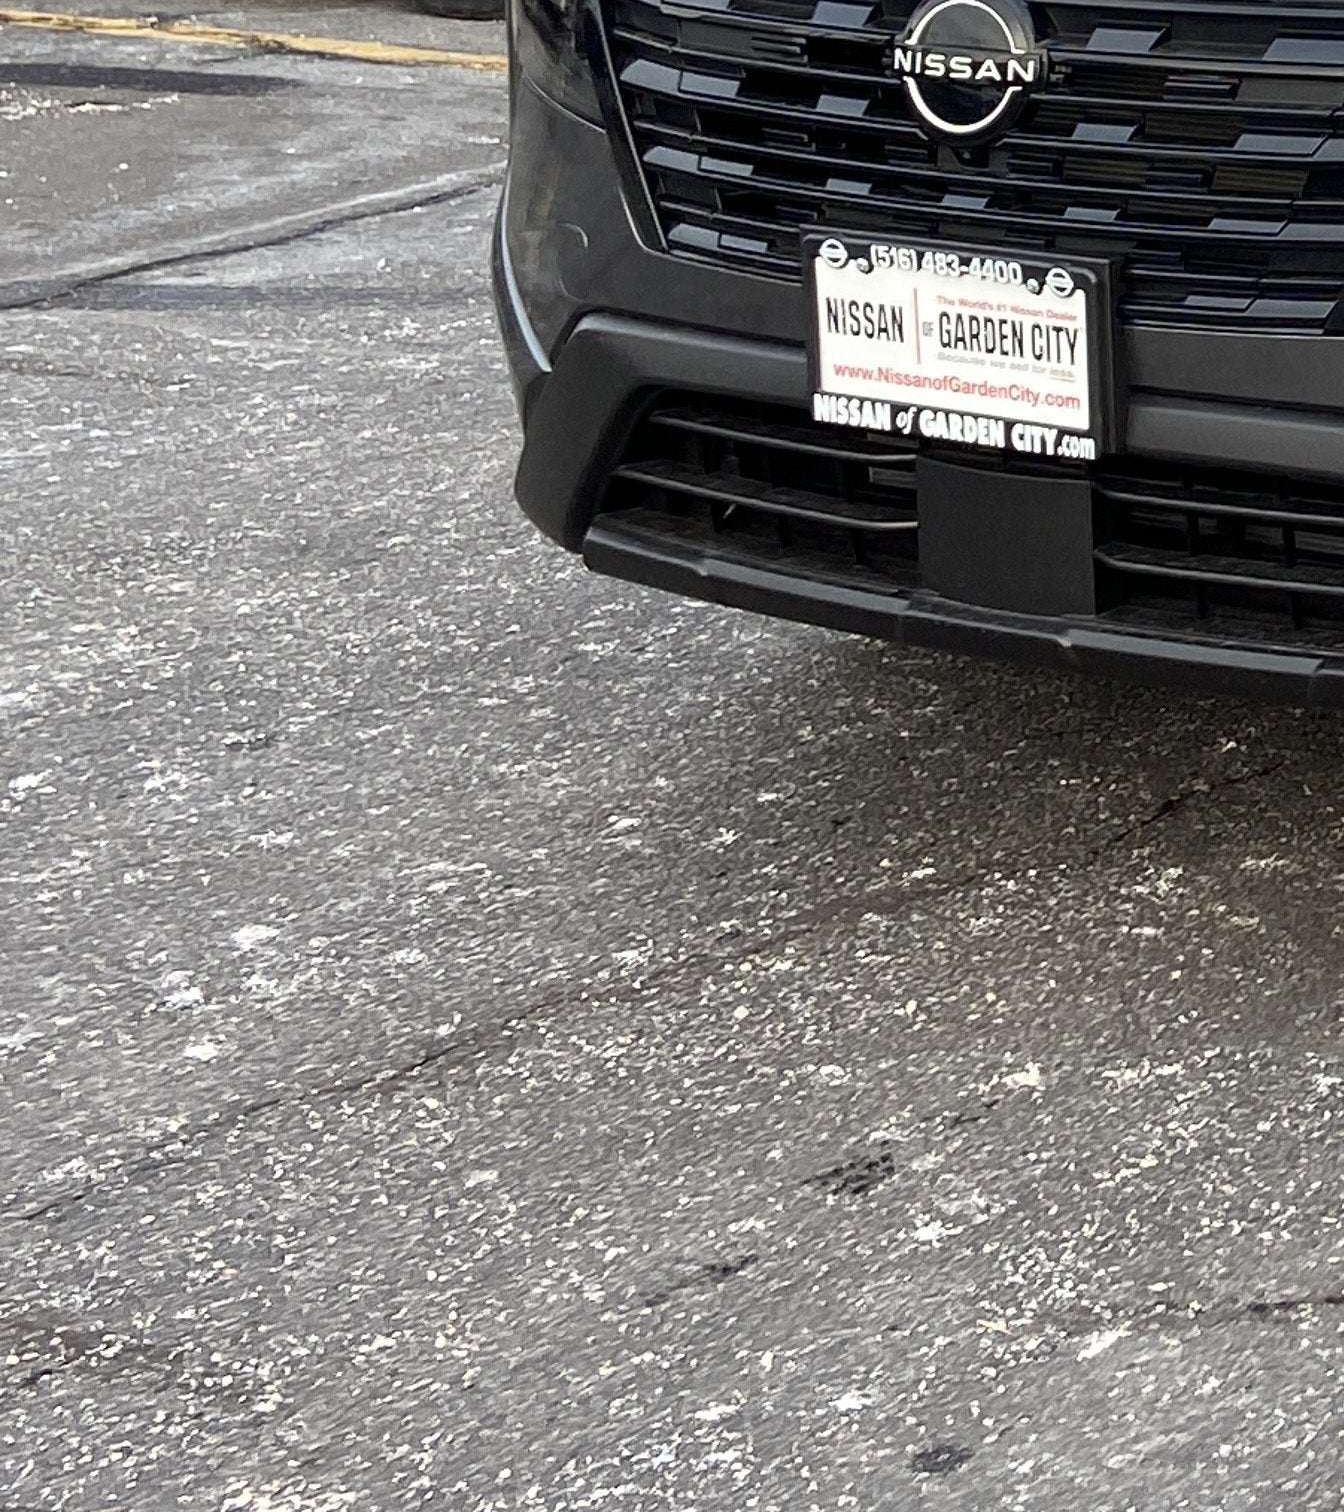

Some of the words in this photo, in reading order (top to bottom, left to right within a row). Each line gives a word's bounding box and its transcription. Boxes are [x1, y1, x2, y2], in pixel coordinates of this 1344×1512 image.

[893, 48, 1036, 82] NISSAN
[869, 243, 918, 273] (516)
[920, 249, 1023, 286] 483-4400
[825, 296, 905, 344] NISSAN
[922, 320, 934, 338] OF
[938, 310, 1025, 358] GARDEN
[1031, 322, 1079, 366] CITY
[832, 361, 1082, 411] www.NissanofGardenCity.com
[813, 392, 891, 432] NISSAN
[895, 406, 918, 435] of
[919, 408, 1006, 449] GARDEN
